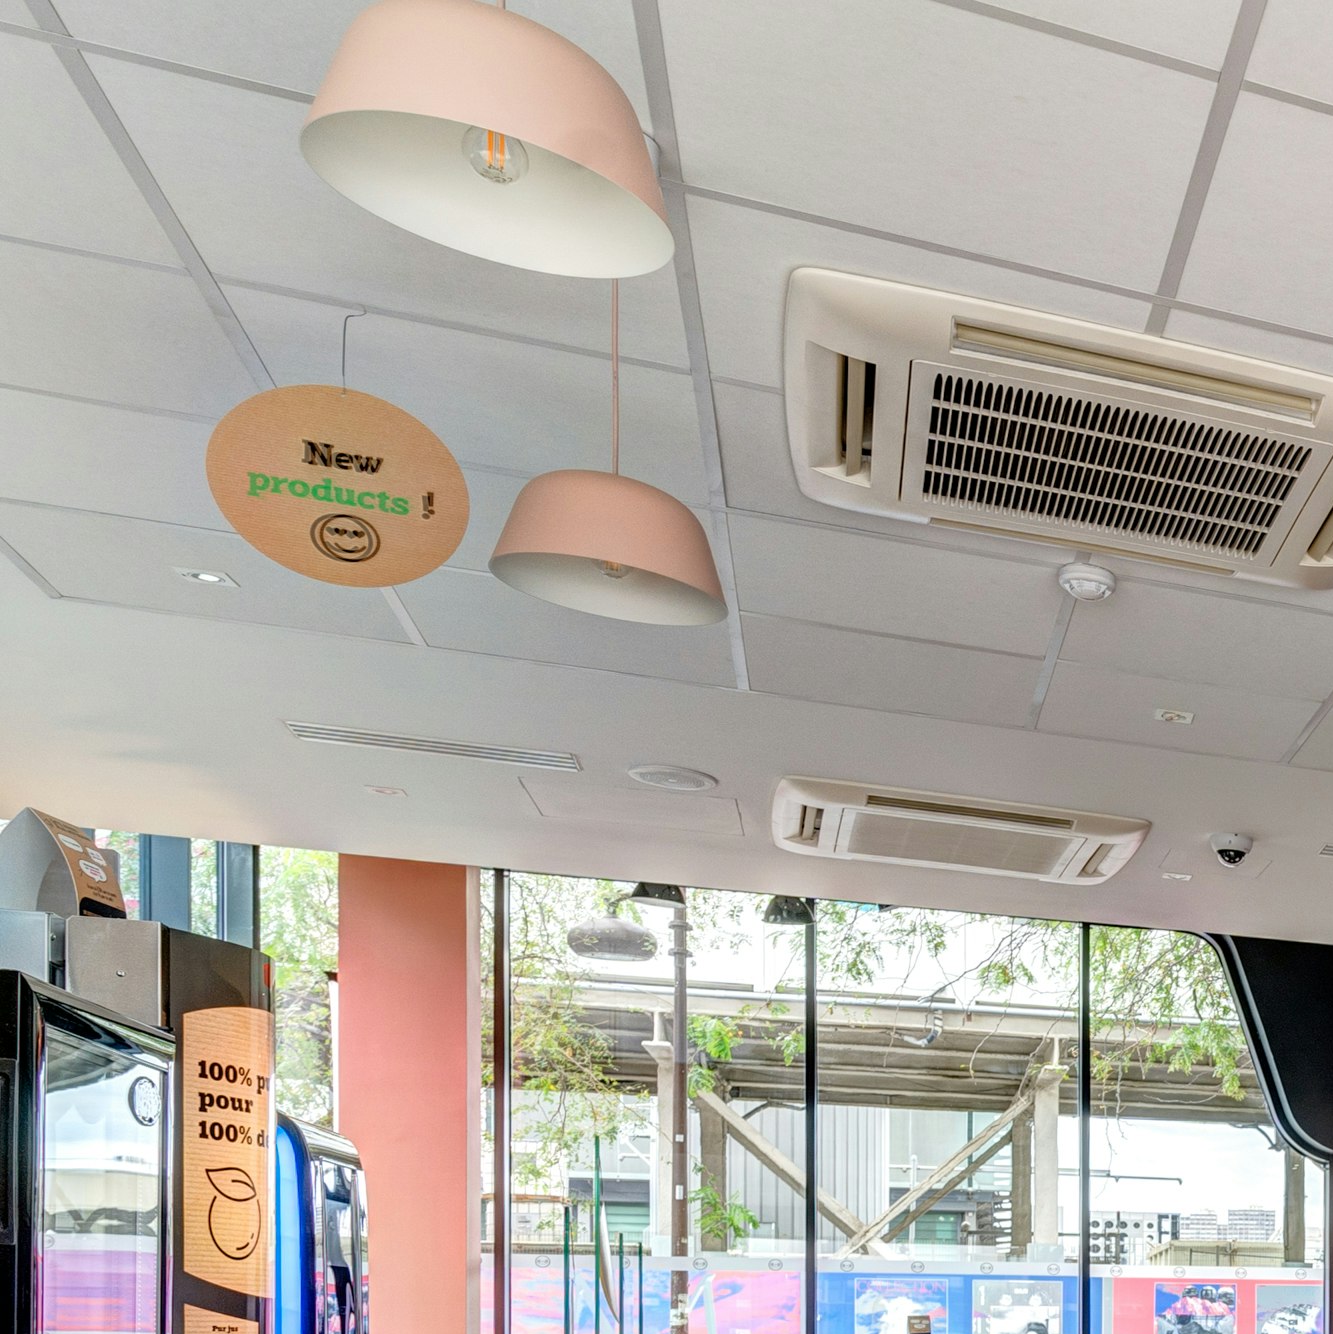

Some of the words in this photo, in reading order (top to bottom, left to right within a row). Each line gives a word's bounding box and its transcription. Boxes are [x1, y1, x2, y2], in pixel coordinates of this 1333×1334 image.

[302, 439, 384, 475] New
[248, 471, 409, 515] products
[421, 492, 435, 520] !
[198, 1060, 252, 1087] 100%
[198, 1092, 253, 1113] pour
[198, 1121, 252, 1145] 100%
[228, 1325, 238, 1333] jus
